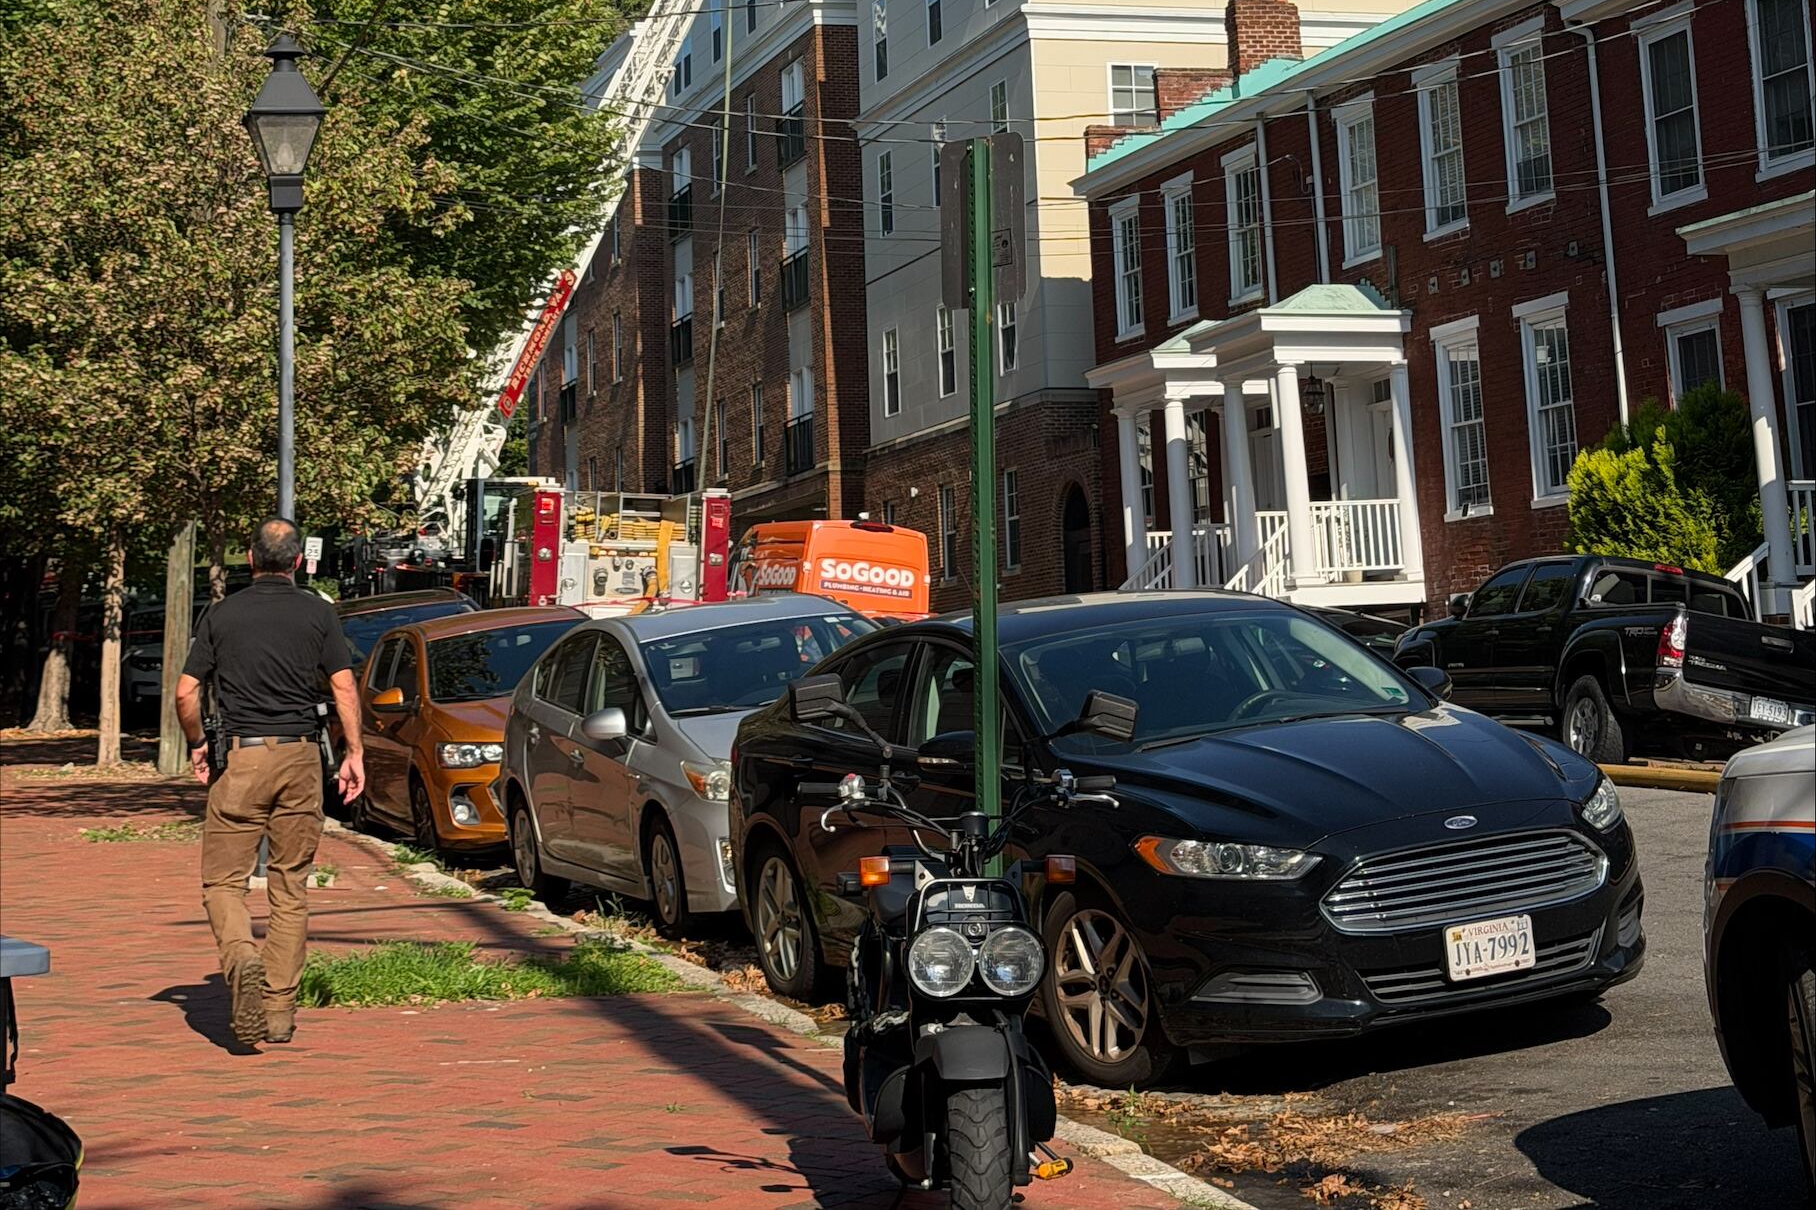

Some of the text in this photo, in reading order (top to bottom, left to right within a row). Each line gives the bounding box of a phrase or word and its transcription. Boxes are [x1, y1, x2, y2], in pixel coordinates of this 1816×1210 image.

[524, 350, 541, 378] TRUCK
[1467, 922, 1509, 937] VIRGINIA
[1455, 931, 1530, 967] JYA-7992
